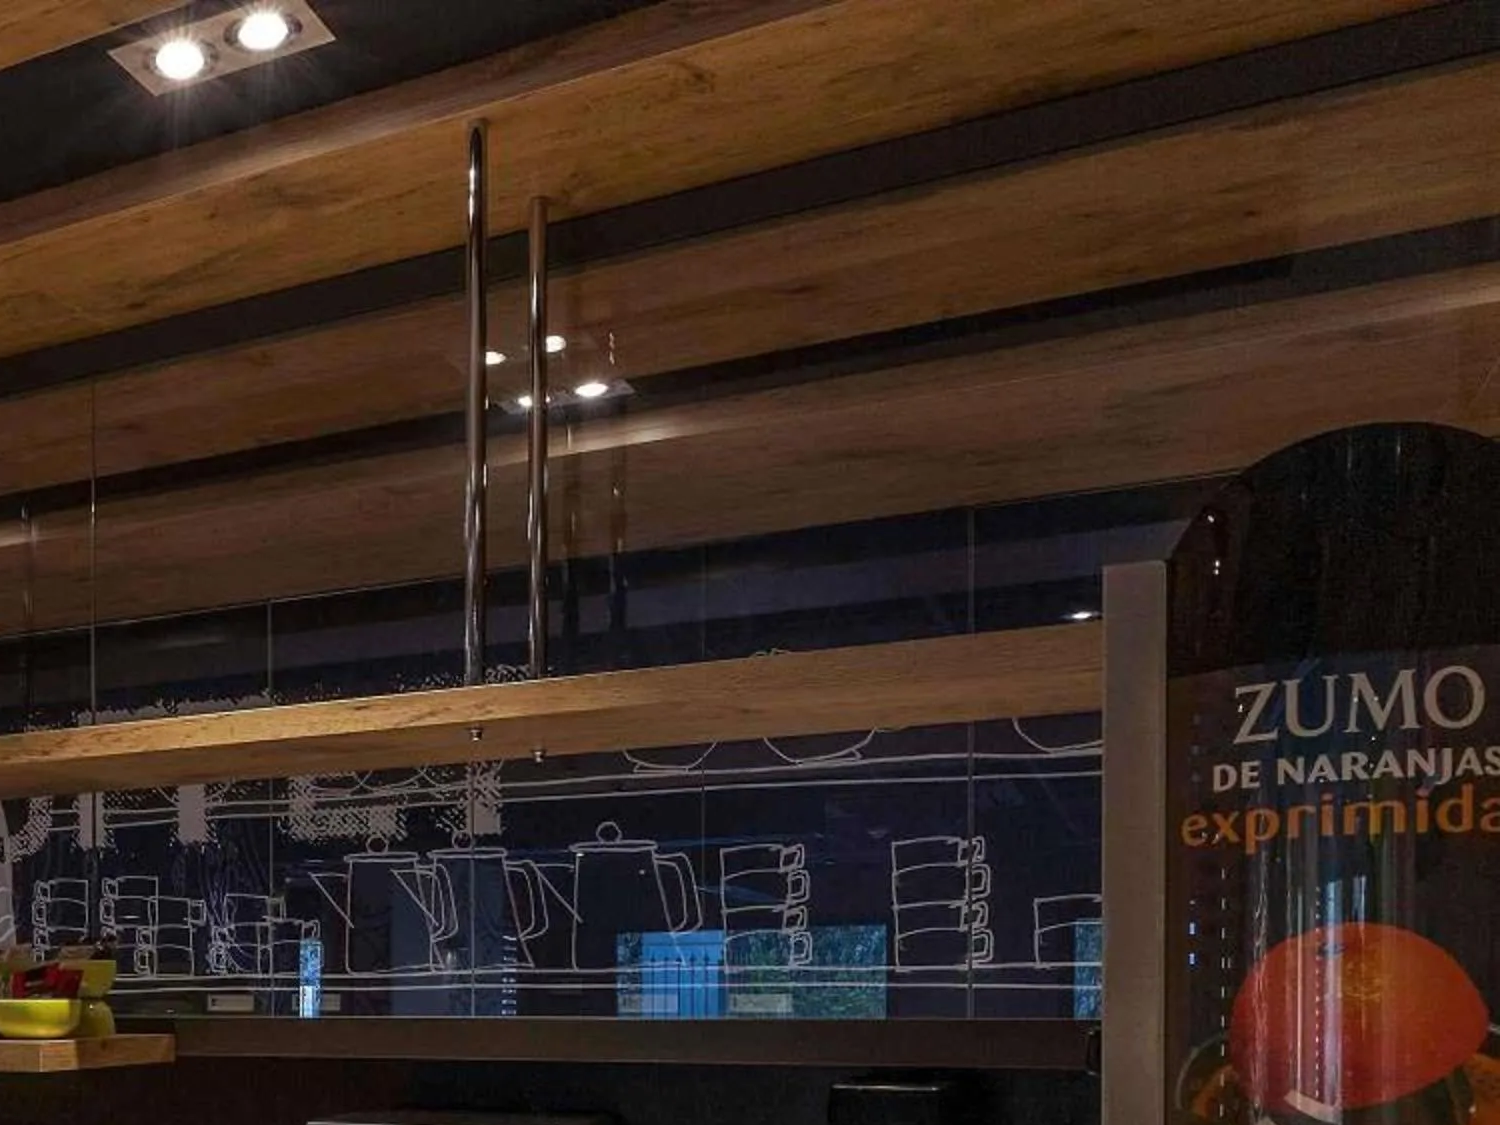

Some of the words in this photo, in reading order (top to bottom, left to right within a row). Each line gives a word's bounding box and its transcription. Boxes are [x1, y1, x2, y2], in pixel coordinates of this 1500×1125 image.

[1233, 666, 1485, 744] ZUMO
[1212, 761, 1260, 792] DE
[1277, 746, 1500, 785] NARANJAS
